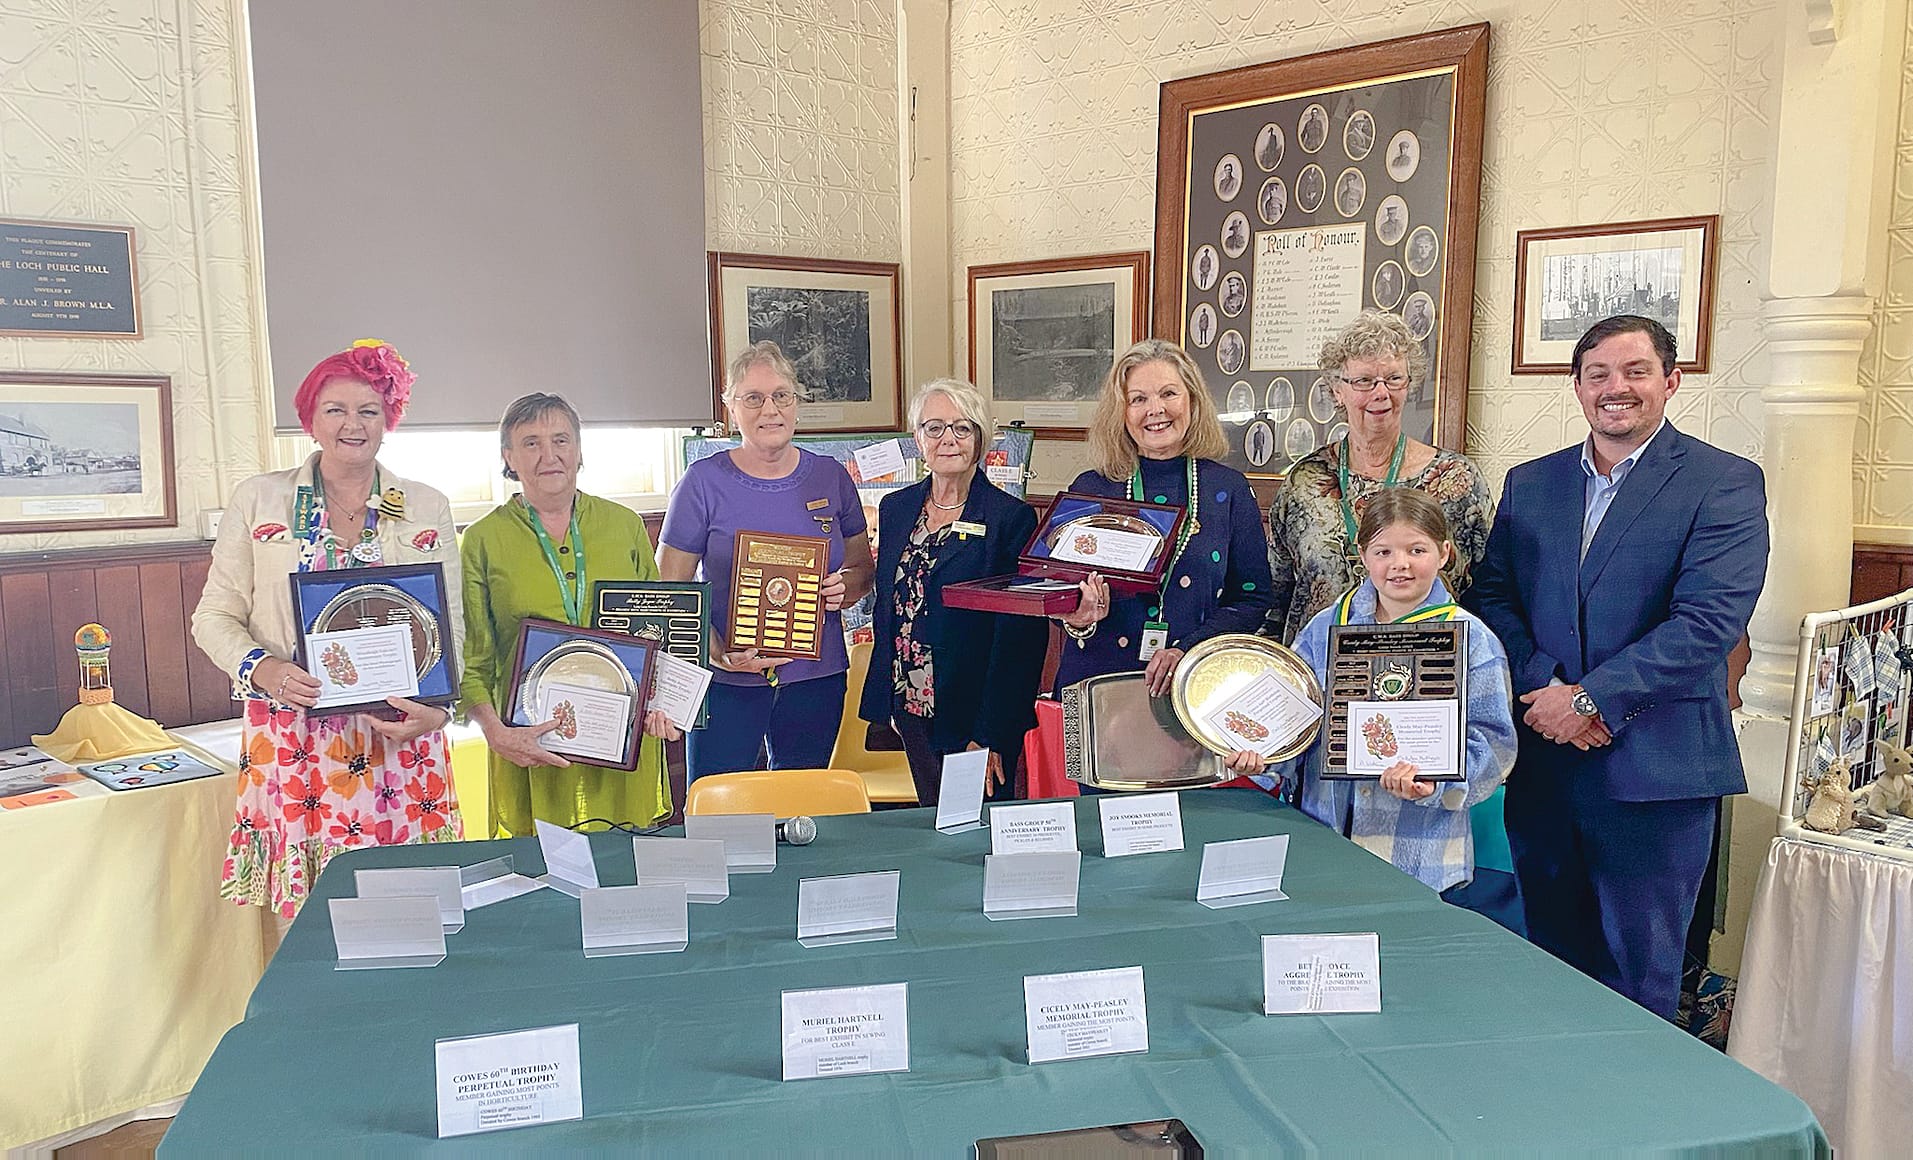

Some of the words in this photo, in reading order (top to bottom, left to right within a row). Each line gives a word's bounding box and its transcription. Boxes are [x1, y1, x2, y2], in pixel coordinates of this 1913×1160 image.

[1262, 233, 1291, 256] Roll
[1295, 232, 1307, 248] of
[1308, 229, 1359, 253] Honour.
[0, 260, 11, 269] HE
[16, 261, 42, 270] LOCH
[47, 263, 80, 272] PUBLIC
[84, 264, 109, 274] HALL
[12, 298, 37, 307] ALAN
[53, 300, 86, 309] BROWN
[299, 494, 308, 530] STEWARD
[1298, 962, 1312, 970] BET
[1328, 962, 1351, 970] OYCE
[1040, 1004, 1071, 1013] CICELY
[1072, 998, 1128, 1010] MAY-PEASLEY
[802, 1017, 836, 1026] MURIEL
[838, 1013, 884, 1024] HARTNELL
[1037, 1023, 1061, 1031] MEMBER
[1062, 1020, 1086, 1028] GAINING
[1115, 1015, 1135, 1023] POINTS
[1045, 1012, 1091, 1023] MEMORIAL
[1092, 1008, 1126, 1018] TROPHY
[826, 1024, 861, 1034] TROPHY
[453, 1071, 489, 1084] COWES
[511, 1062, 560, 1076] BIRTHDAY
[458, 1079, 515, 1093] PERPETUAL
[517, 1073, 556, 1085] TROPHY
[455, 1092, 485, 1101] MEMBER
[486, 1088, 515, 1098] GAINING
[516, 1085, 535, 1093] MOST
[536, 1082, 560, 1091] POINTS
[478, 1099, 486, 1107] IN
[487, 1093, 537, 1106] HORTICULTURE
